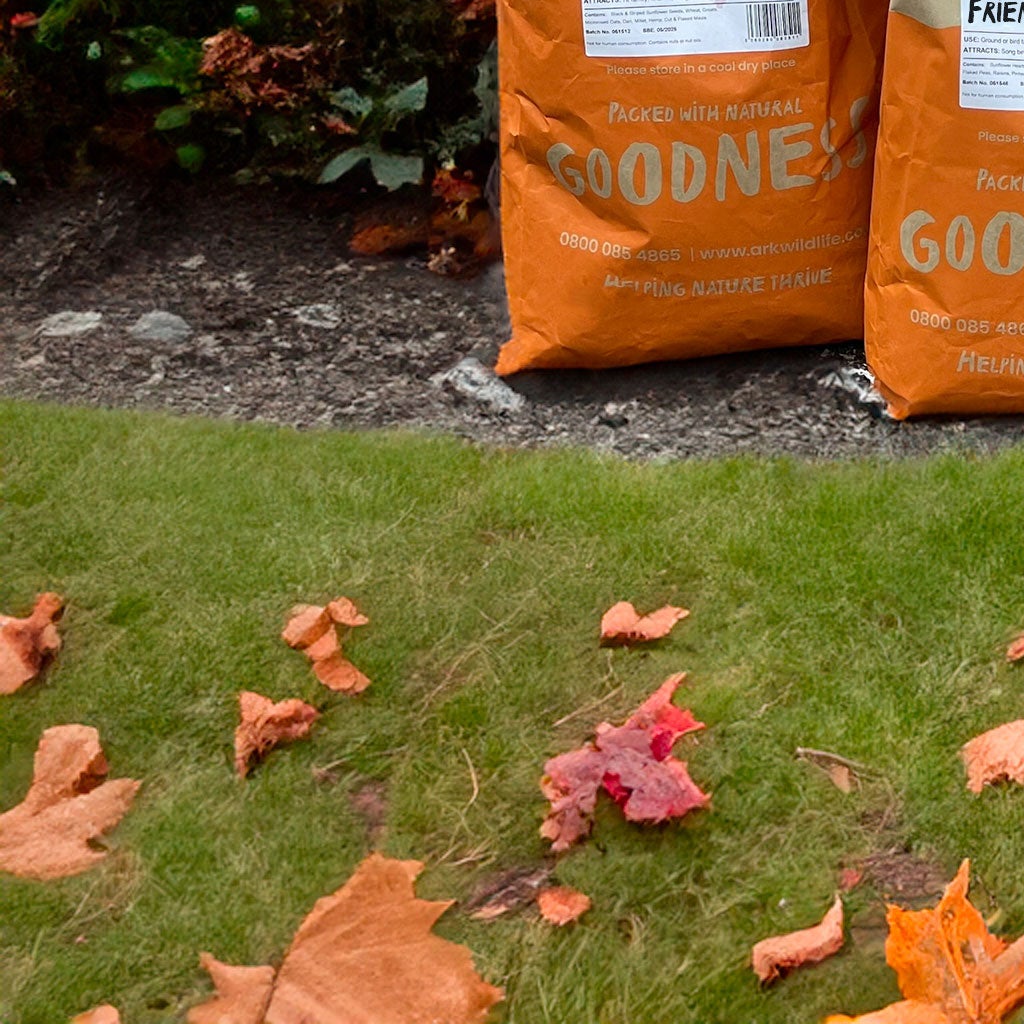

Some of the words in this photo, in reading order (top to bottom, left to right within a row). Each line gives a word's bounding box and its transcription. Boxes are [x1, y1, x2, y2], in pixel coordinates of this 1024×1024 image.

[1001, 48, 1016, 56] Song
[607, 64, 646, 75] Please
[650, 63, 681, 74] store
[684, 62, 695, 73] in
[709, 61, 735, 72] cool
[738, 60, 758, 74] dry
[761, 57, 796, 72] place
[608, 101, 674, 124] PACKED
[679, 100, 719, 121] WITH
[726, 97, 803, 121] NATURAL
[978, 131, 1019, 143] Please
[546, 96, 868, 205] GOODNESS
[559, 231, 597, 253] 0800
[601, 240, 632, 260] 085
[636, 248, 681, 262] 4865
[692, 276, 765, 296] NATURE
[771, 266, 832, 290] THRIVE
[910, 309, 951, 330] 0800
[955, 319, 990, 334] 085
